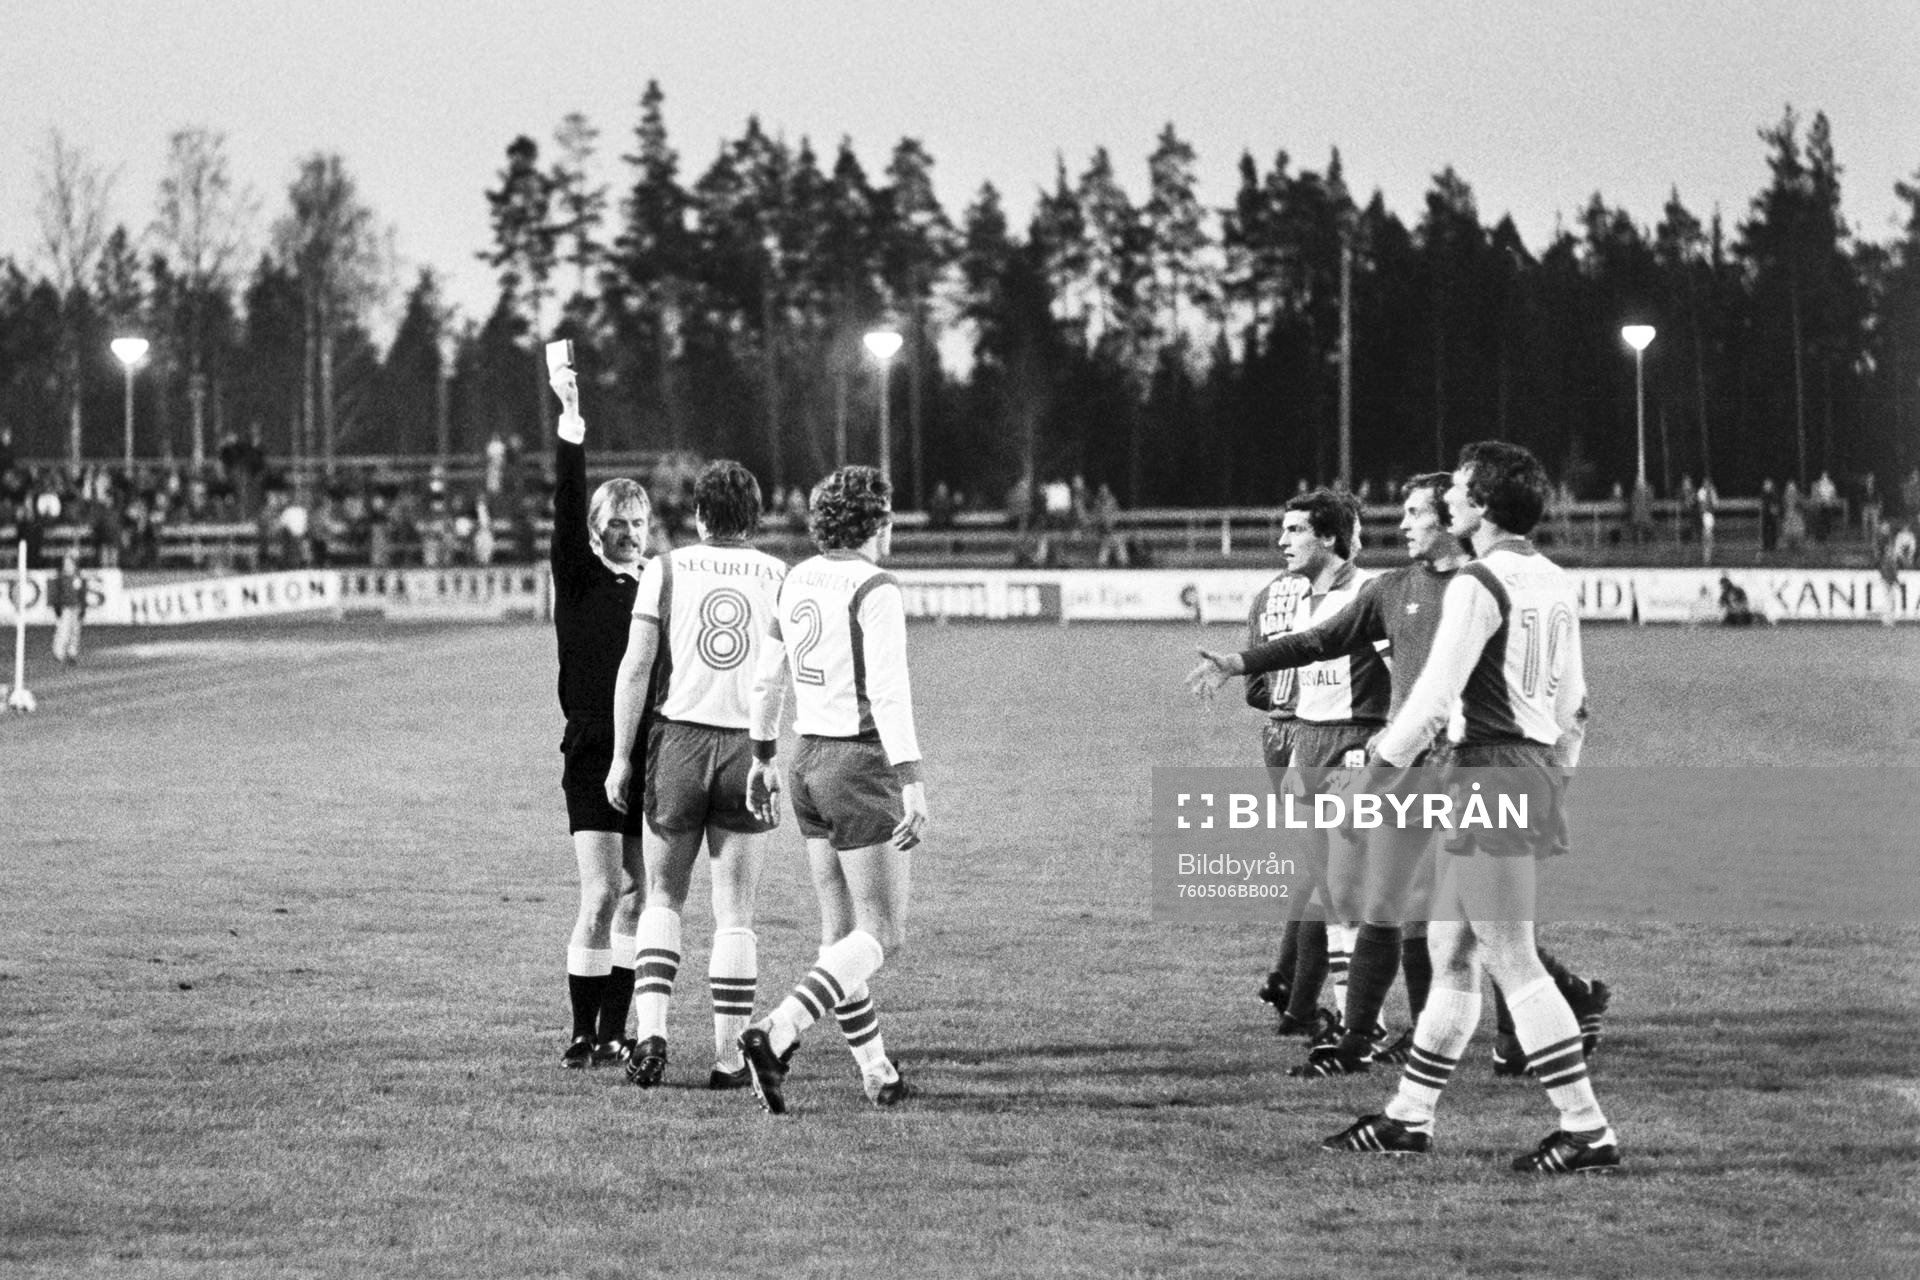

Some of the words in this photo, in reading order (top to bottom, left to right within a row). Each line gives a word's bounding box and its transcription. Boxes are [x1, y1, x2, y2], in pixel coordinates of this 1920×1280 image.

[677, 558, 785, 583] SECURITAS
[696, 587, 751, 671] 8
[790, 598, 826, 686] 2
[1521, 602, 1573, 698] 10
